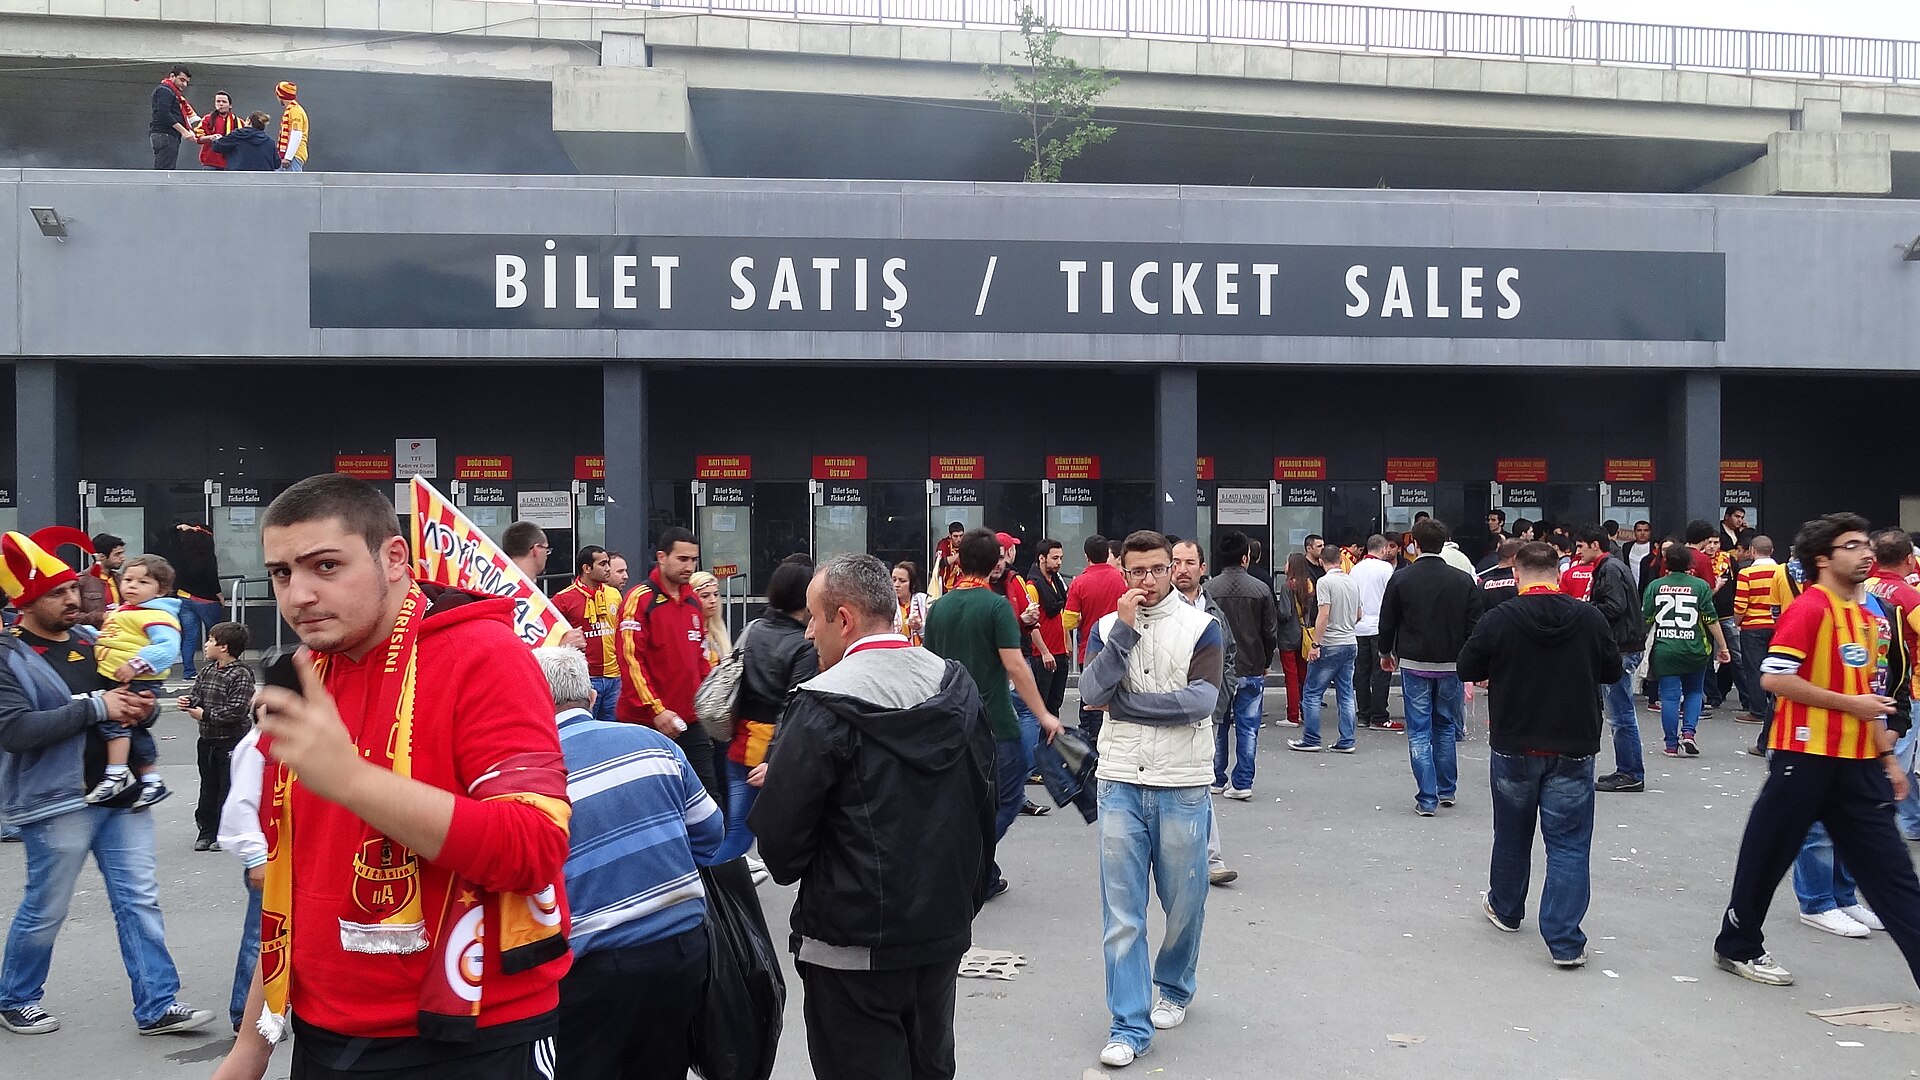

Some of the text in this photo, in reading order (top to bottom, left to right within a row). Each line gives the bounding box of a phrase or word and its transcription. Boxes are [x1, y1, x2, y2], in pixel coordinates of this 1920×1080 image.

[495, 239, 1521, 328] BİLET SATIŞ / TICKET SALES
[1279, 459, 1321, 468] PEGASUS TRİBÜN
[470, 470, 480, 478] KAT
[498, 470, 508, 478] KAT
[714, 566, 736, 575] KAPALI
[1655, 594, 1698, 629] 25
